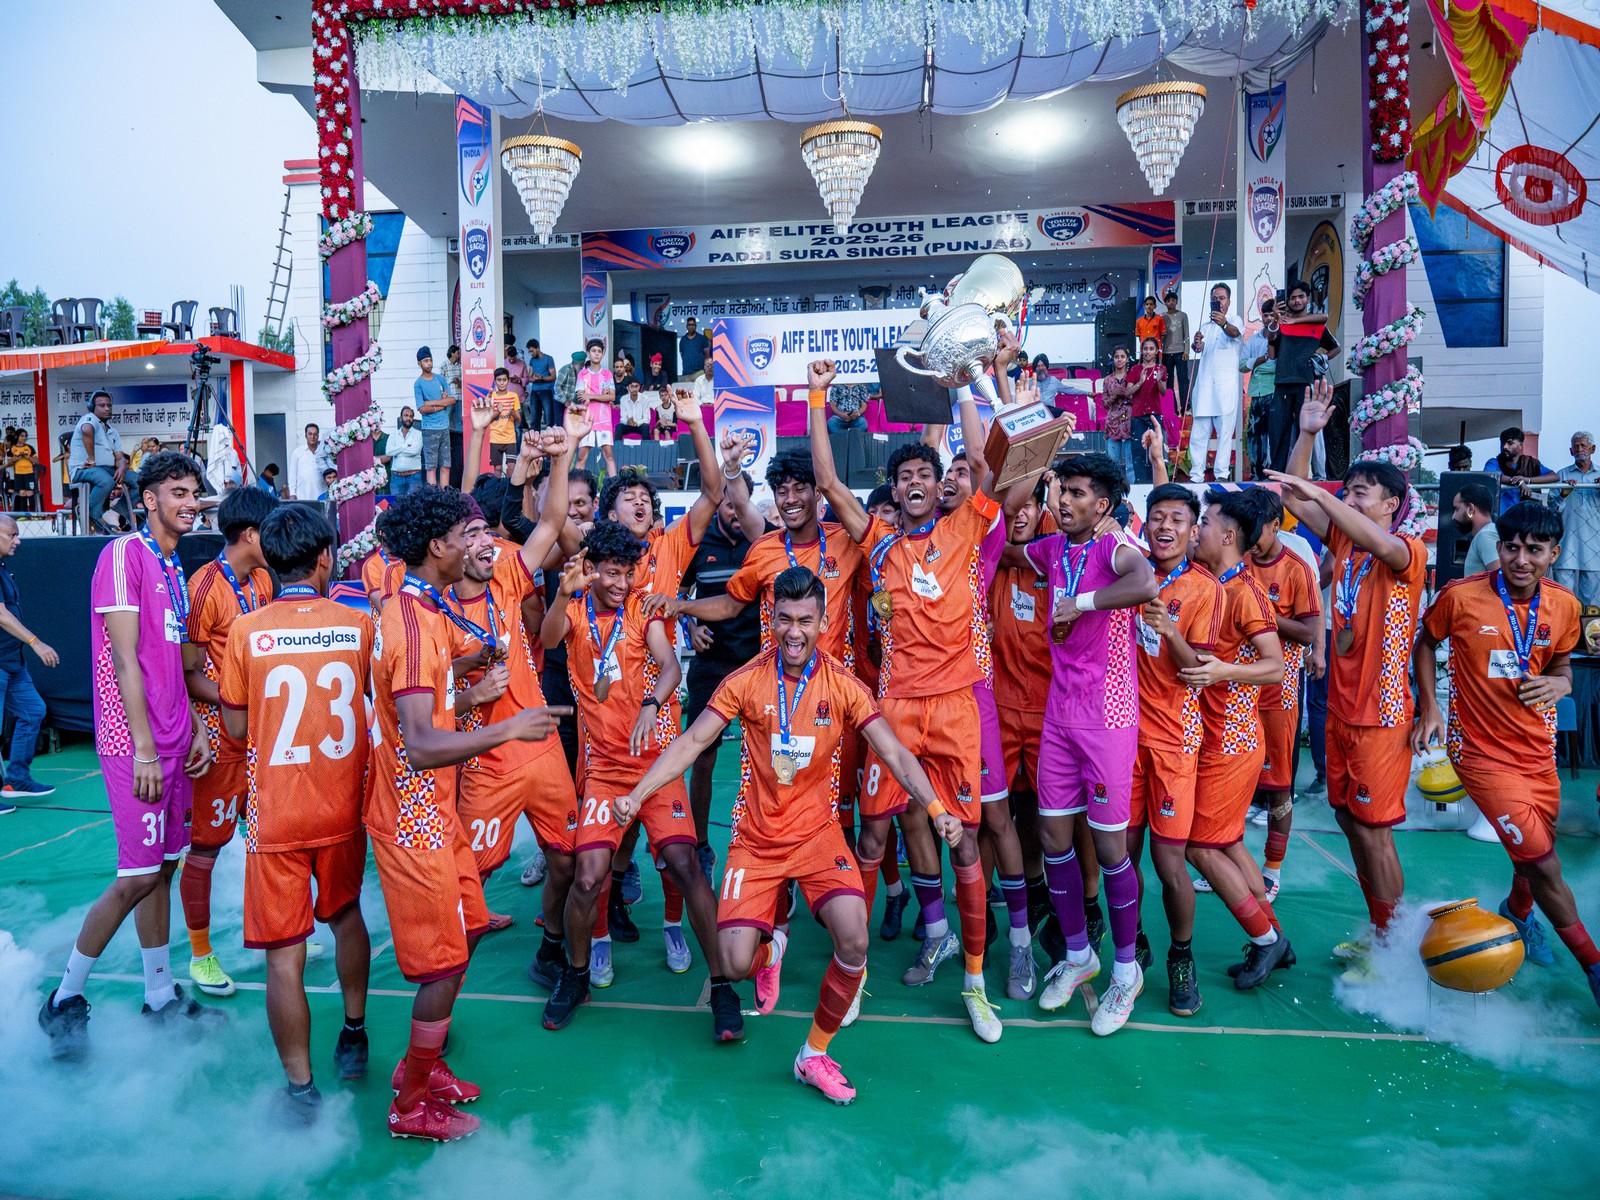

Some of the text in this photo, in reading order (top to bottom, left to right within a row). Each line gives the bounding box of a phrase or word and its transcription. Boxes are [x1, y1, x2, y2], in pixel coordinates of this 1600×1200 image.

[463, 149, 481, 158] INDIA
[1257, 177, 1275, 185] INDIA
[1254, 193, 1276, 204] YOUTH
[1290, 198, 1307, 208] SURA
[1308, 196, 1328, 207] SINGH
[1225, 201, 1237, 212] SPO
[1253, 201, 1277, 213] LEAGUE
[709, 213, 1029, 239] AIFF ELITE YOUTH LEAGUE
[1046, 221, 1080, 229] LEAGUE
[1048, 217, 1077, 225] YOUTH
[467, 235, 485, 244] YOUTH
[811, 233, 924, 246] 2025-26
[466, 243, 486, 253] LEAGUE
[708, 238, 1032, 262] PADDI SURA SINGH (PUNJAB)
[896, 286, 915, 300] ਮੀਰੀ
[702, 301, 726, 315] ਸਾਹਿਬ
[1034, 301, 1060, 315] ਸਾਹਿਬ
[781, 325, 909, 354] AIFF ELITE YOUTH LEA
[835, 359, 878, 374] 2025-2
[277, 630, 357, 648] roundglass
[264, 661, 357, 767] 23
[772, 748, 811, 760] rodglass
[866, 763, 881, 797] 8
[211, 795, 238, 827] 34
[582, 797, 610, 826] 26
[142, 809, 166, 847] 31
[470, 817, 501, 851] 20
[1497, 814, 1524, 846] 5
[722, 867, 746, 901] 11
